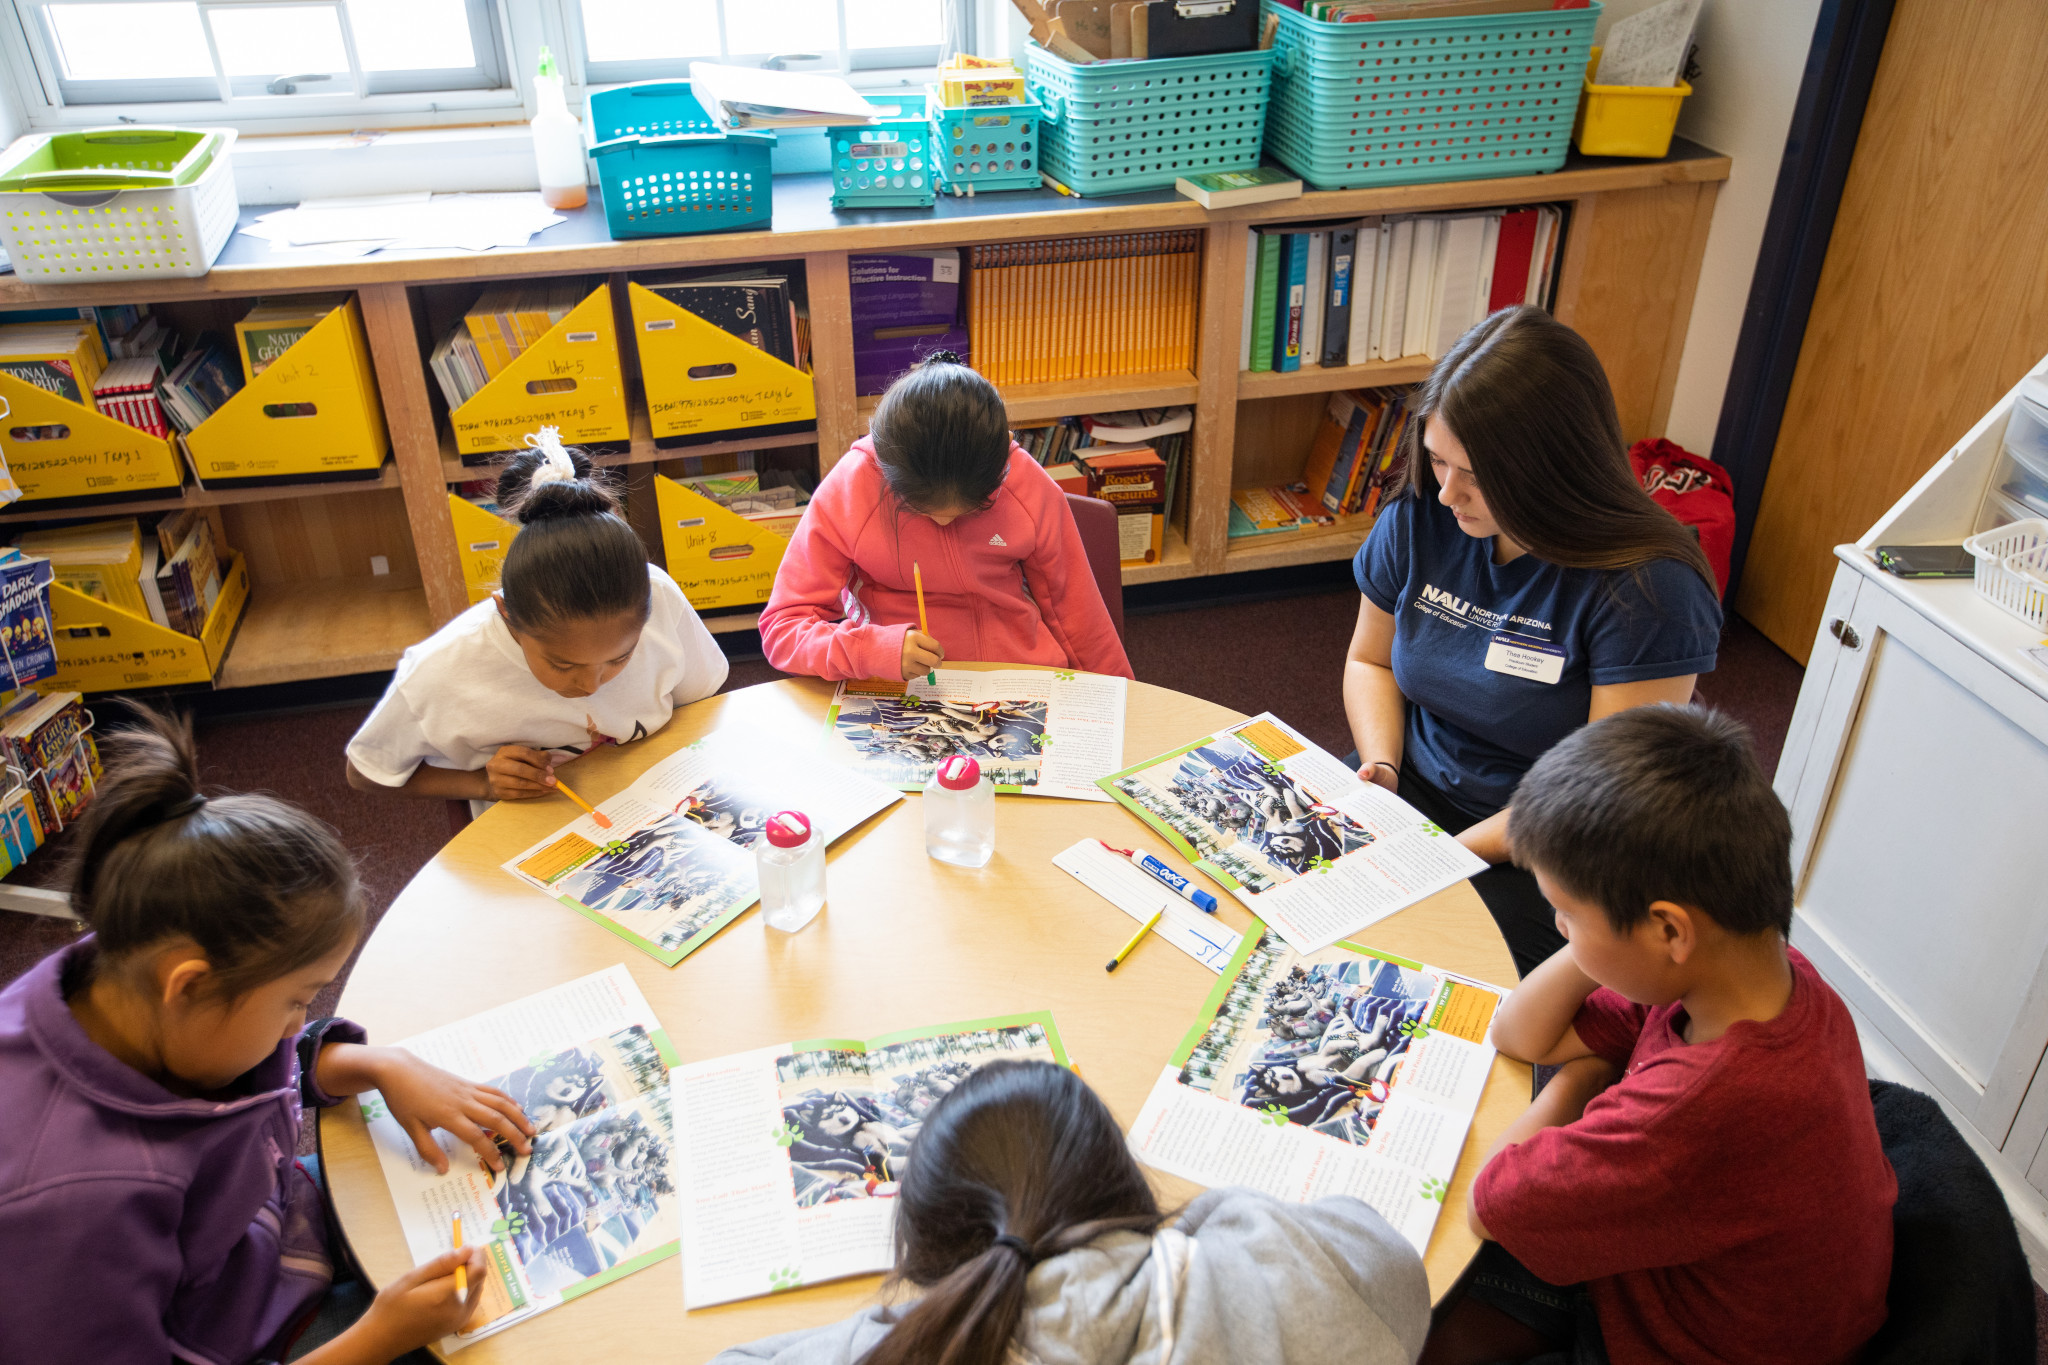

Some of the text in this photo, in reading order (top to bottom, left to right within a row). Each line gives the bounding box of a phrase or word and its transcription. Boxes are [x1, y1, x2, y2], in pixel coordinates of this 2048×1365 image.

[851, 265, 899, 275] Solutions for
[851, 274, 927, 284] Effective Instruction
[736, 288, 759, 324] Sang
[276, 364, 319, 385] Unit 2
[548, 359, 584, 375] Unit 5
[784, 386, 793, 398] 6
[588, 405, 599, 415] 5
[134, 450, 141, 460] 1
[1105, 472, 1151, 486] Roget's
[1092, 489, 1158, 501] Thesaurus
[685, 531, 717, 549] Unit 8
[2, 573, 35, 600] DARK
[1421, 583, 1470, 616] NAU
[1413, 601, 1433, 614] College
[1439, 613, 1468, 629] Education
[1509, 615, 1552, 630] ARIZONA
[26, 651, 50, 667] CRONIN
[178, 648, 187, 657] 3
[43, 717, 67, 745] Little
[39, 718, 82, 763] Legends
[1157, 864, 1187, 889] EXPO
[1195, 940, 1213, 959] S
